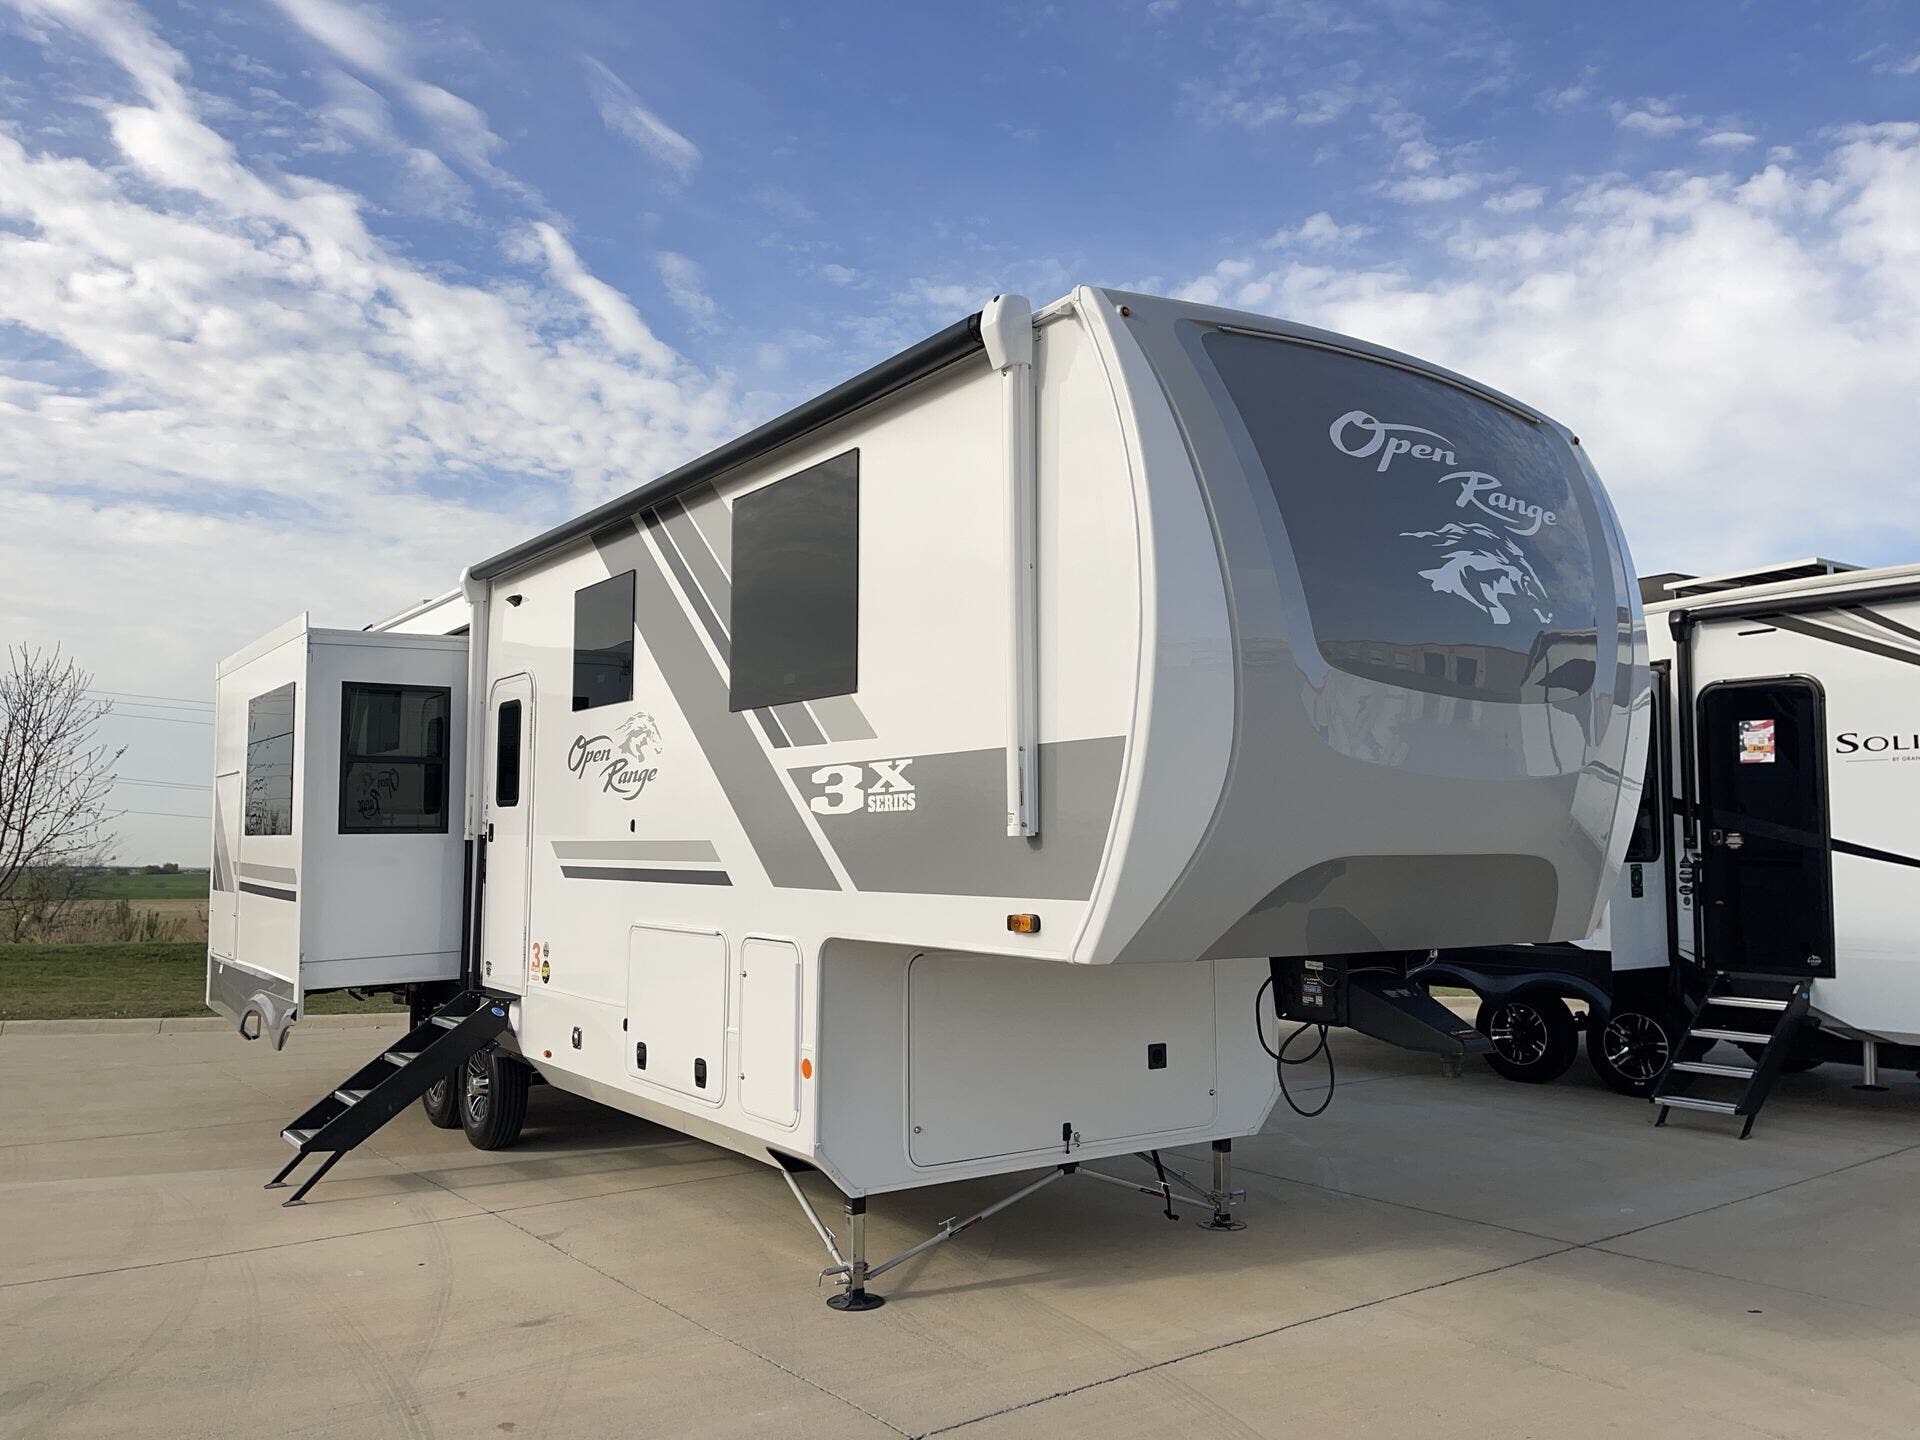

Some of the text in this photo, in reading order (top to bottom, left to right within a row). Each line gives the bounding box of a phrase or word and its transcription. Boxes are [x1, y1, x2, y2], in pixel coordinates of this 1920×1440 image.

[1329, 410, 1458, 472] Open
[1438, 470, 1557, 536] Range
[568, 735, 613, 780] Open
[1836, 732, 1920, 754] SOLI
[599, 758, 657, 801] Range
[867, 793, 916, 812] SERIES
